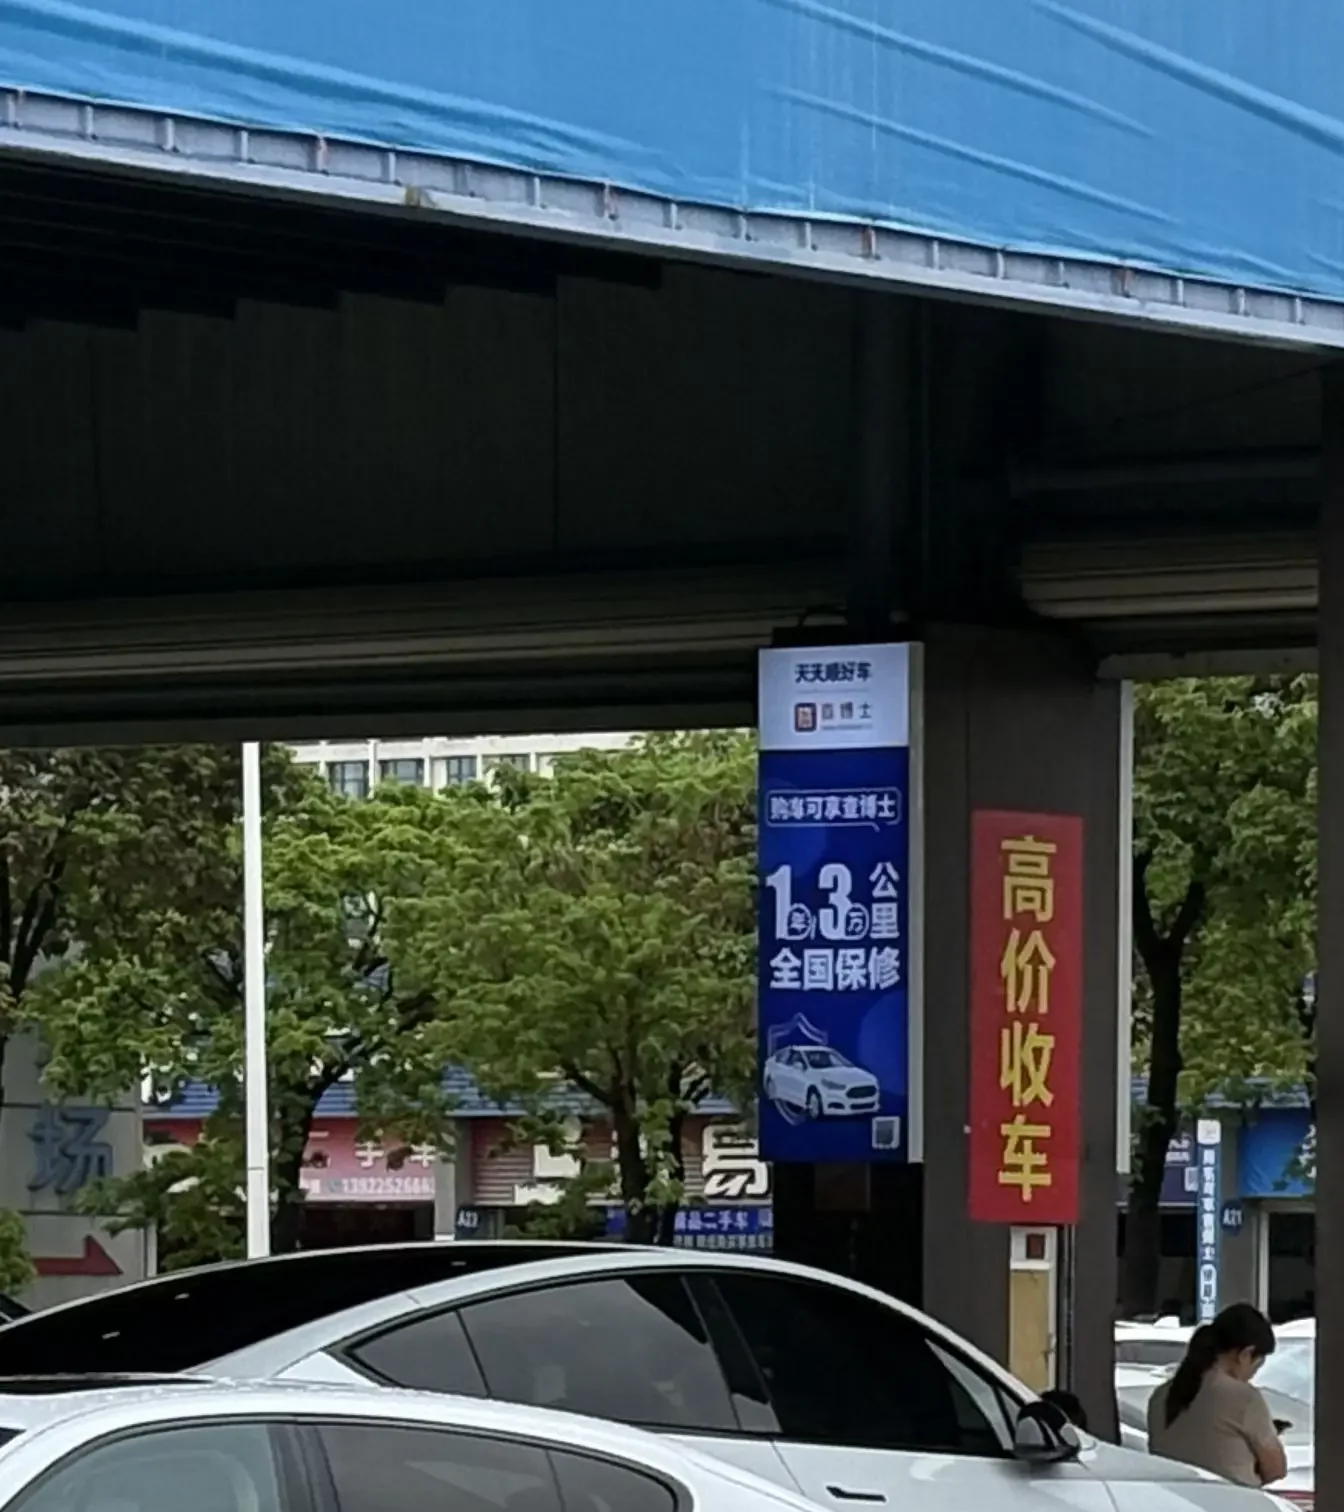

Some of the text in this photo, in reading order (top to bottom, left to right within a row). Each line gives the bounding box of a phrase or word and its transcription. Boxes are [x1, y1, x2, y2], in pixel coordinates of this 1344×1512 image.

[770, 794, 896, 820] 购车可享查博士
[769, 947, 901, 991] 全国保修
[1000, 834, 1057, 1202] 高价收车
